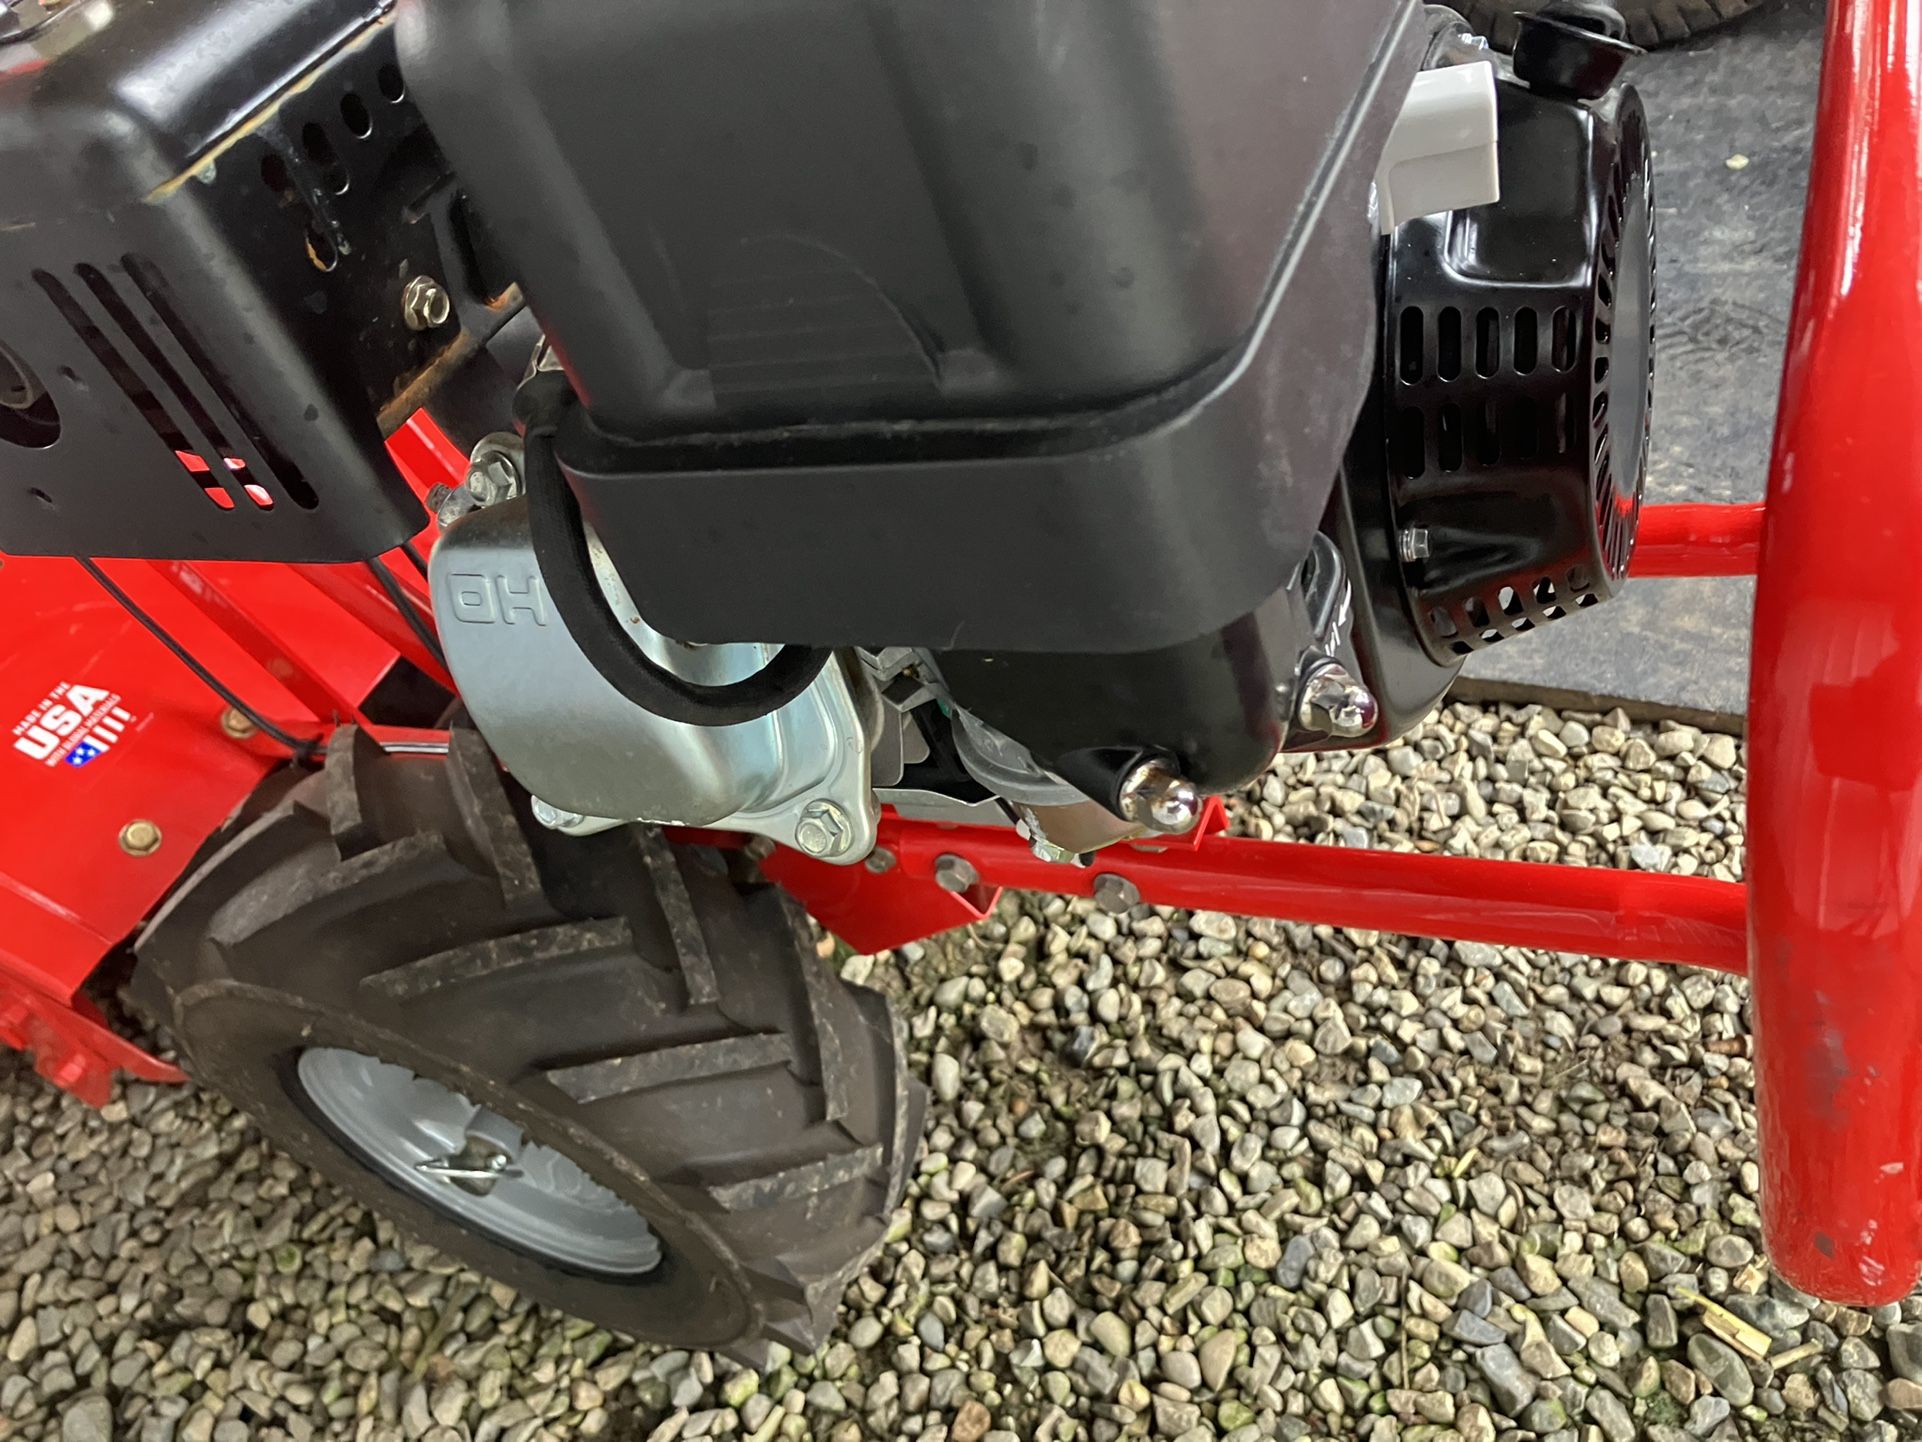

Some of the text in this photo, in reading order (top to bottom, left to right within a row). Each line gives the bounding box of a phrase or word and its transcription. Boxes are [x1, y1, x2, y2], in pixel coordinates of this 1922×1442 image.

[12, 681, 71, 736] MADE IN THE
[13, 684, 110, 760] USA
